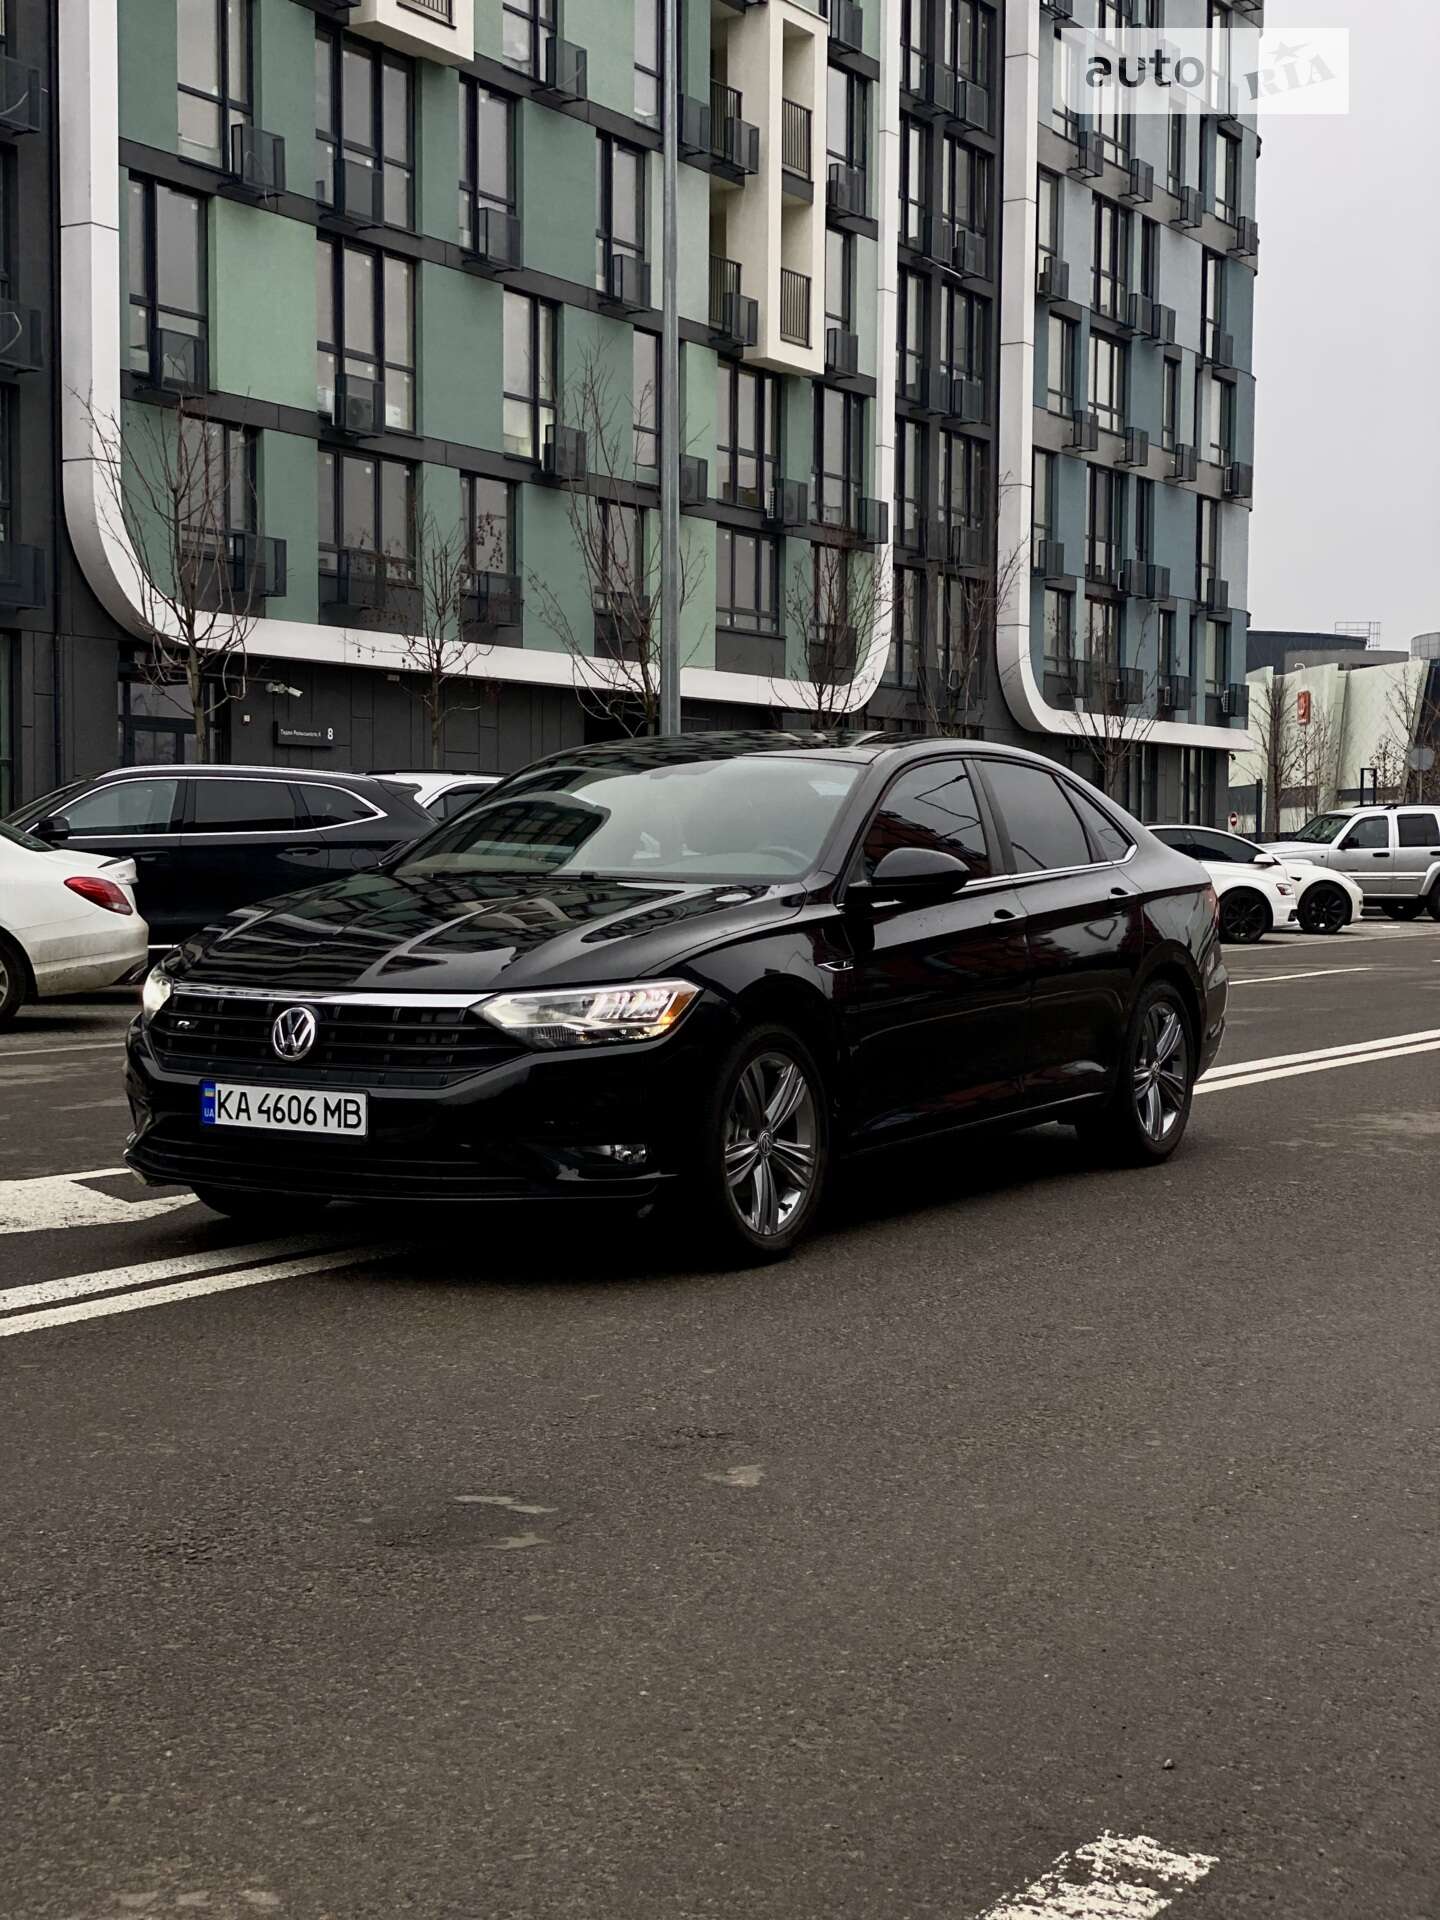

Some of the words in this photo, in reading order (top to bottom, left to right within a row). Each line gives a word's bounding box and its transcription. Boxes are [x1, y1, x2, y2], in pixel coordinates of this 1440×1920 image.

[327, 727, 334, 740] 8
[203, 1107, 215, 1118] UA
[217, 1089, 252, 1121] KA
[257, 1092, 318, 1125] 4606
[323, 1096, 362, 1129] MB
